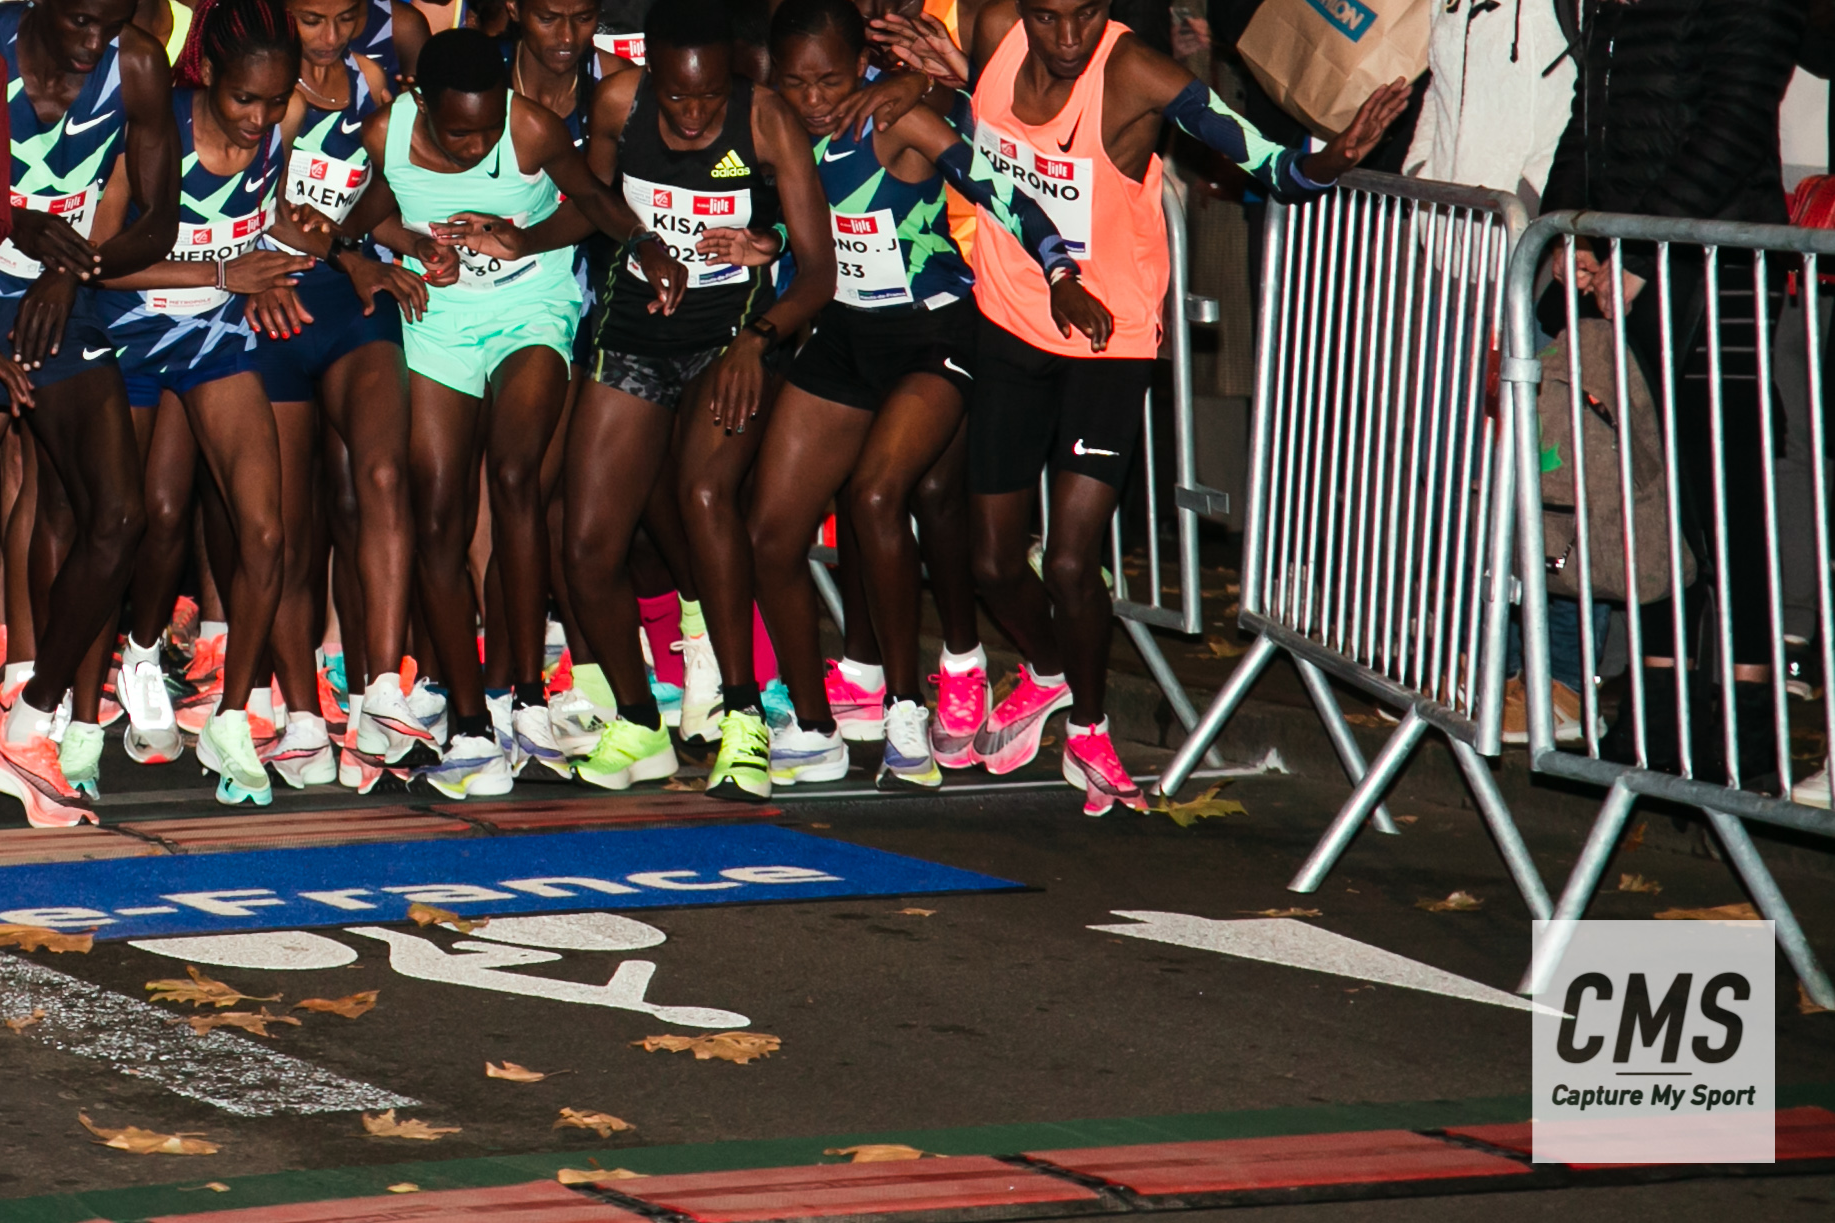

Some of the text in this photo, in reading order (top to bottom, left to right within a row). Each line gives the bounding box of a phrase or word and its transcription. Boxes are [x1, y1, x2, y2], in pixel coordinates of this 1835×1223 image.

[710, 166, 751, 178] adidas
[979, 144, 1080, 201] KIPRONO
[296, 179, 359, 208] ALEMU
[653, 212, 708, 237] KISA
[833, 238, 868, 254] NO
[887, 238, 898, 252] J
[838, 260, 865, 279] 33
